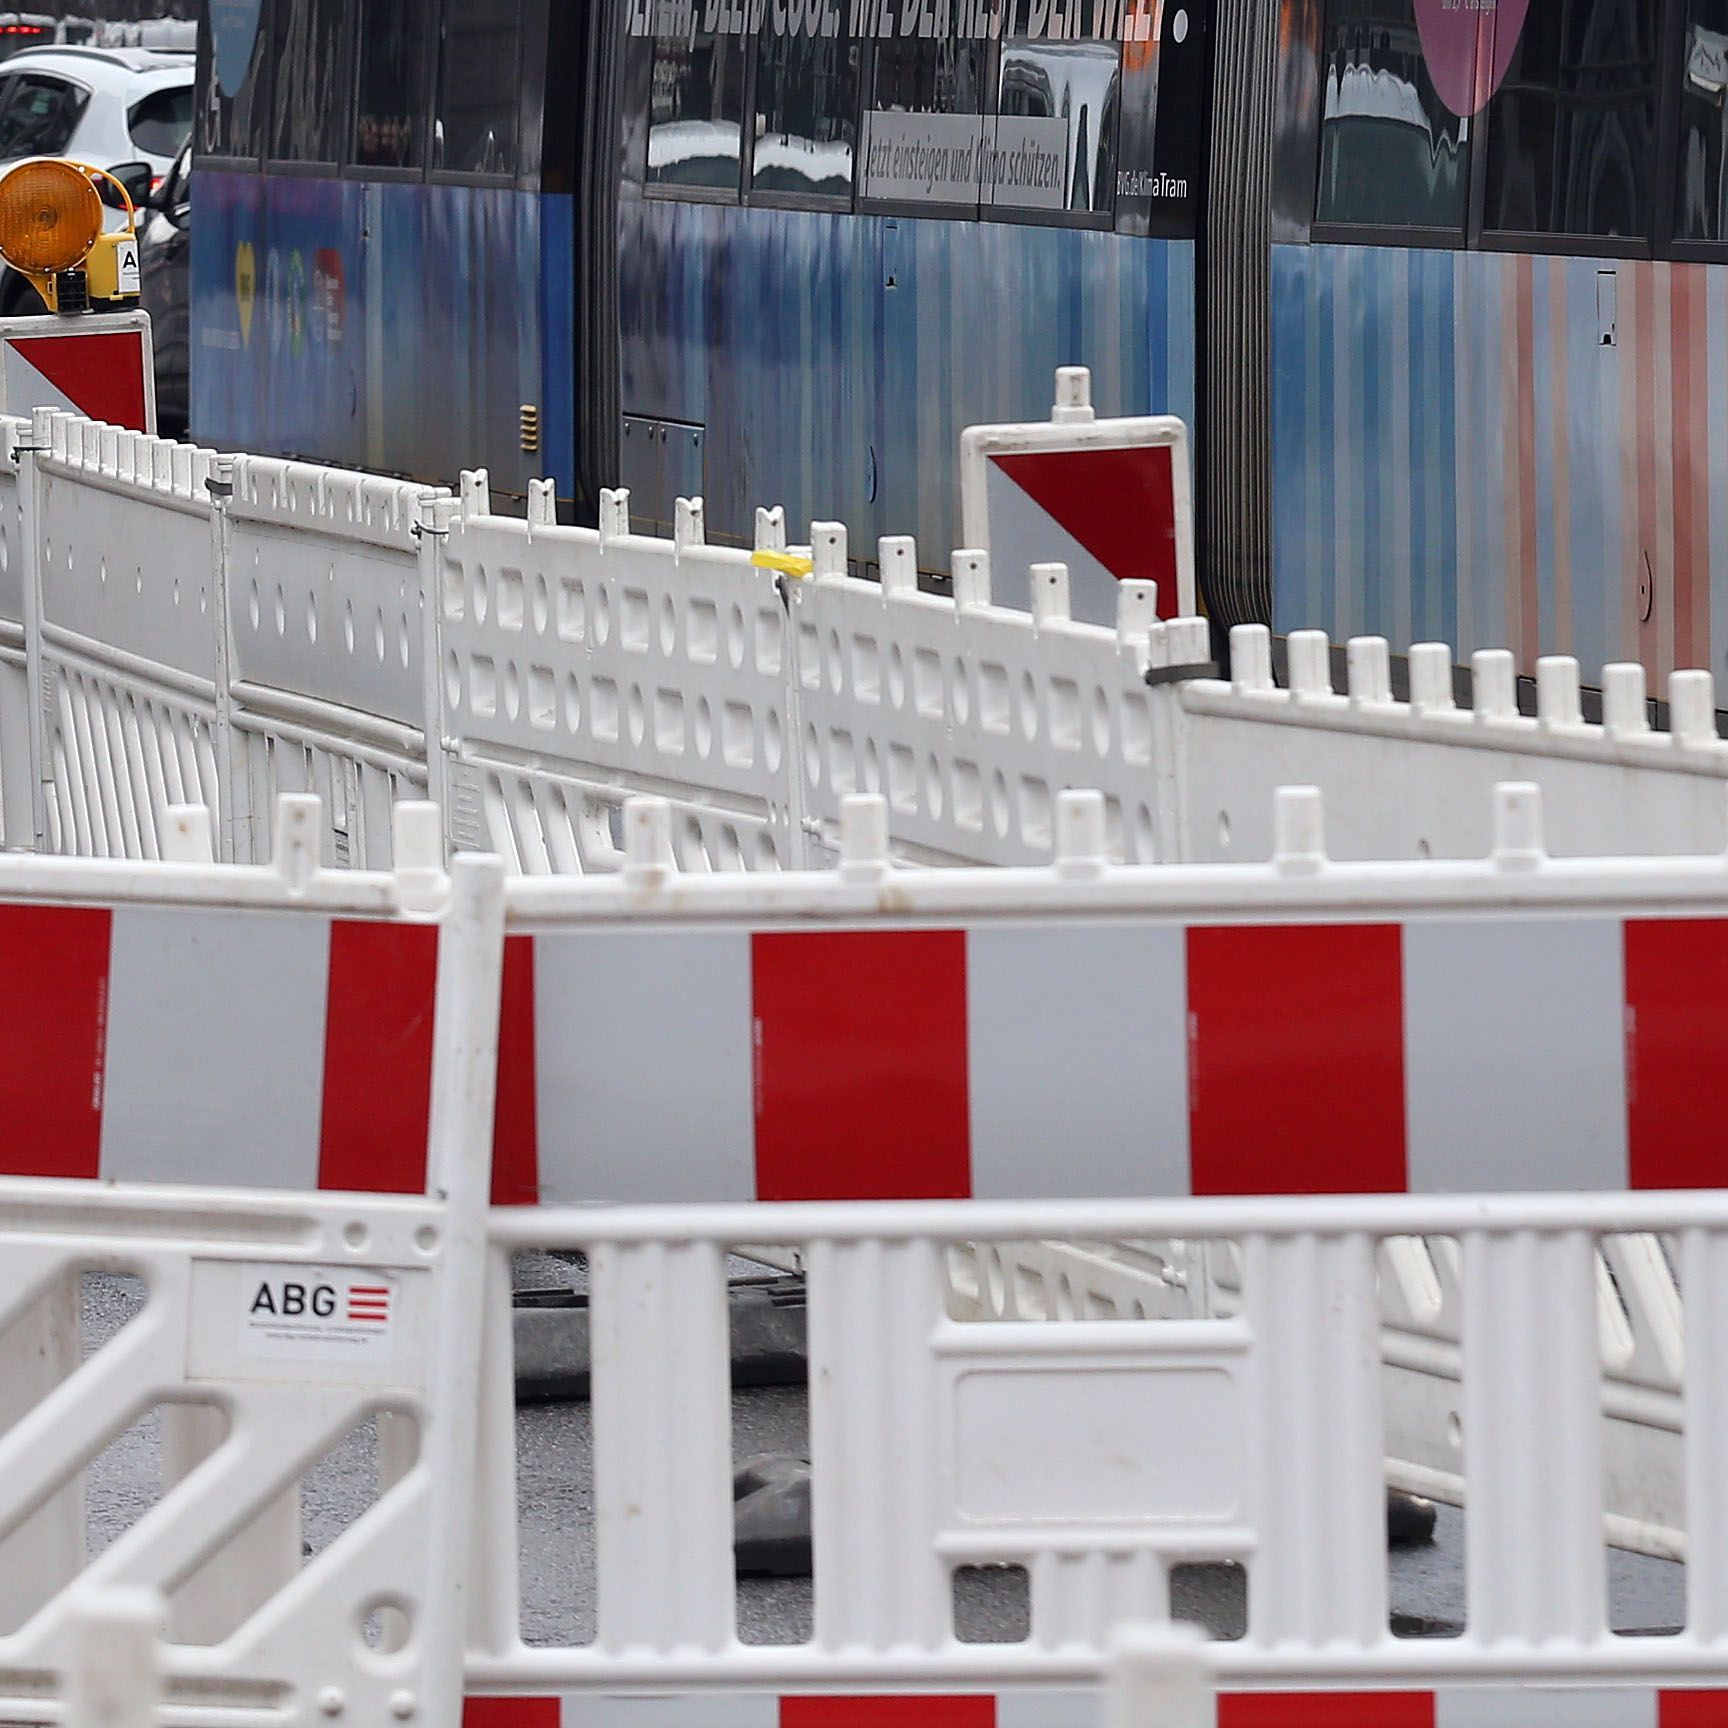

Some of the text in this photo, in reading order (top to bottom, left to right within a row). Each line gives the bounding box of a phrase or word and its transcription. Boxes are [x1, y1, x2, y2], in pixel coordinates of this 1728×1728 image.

[892, 133, 949, 195] einsteigen
[949, 135, 974, 184] und
[1006, 136, 1062, 191] schützen.
[249, 1282, 337, 1317] ABG
